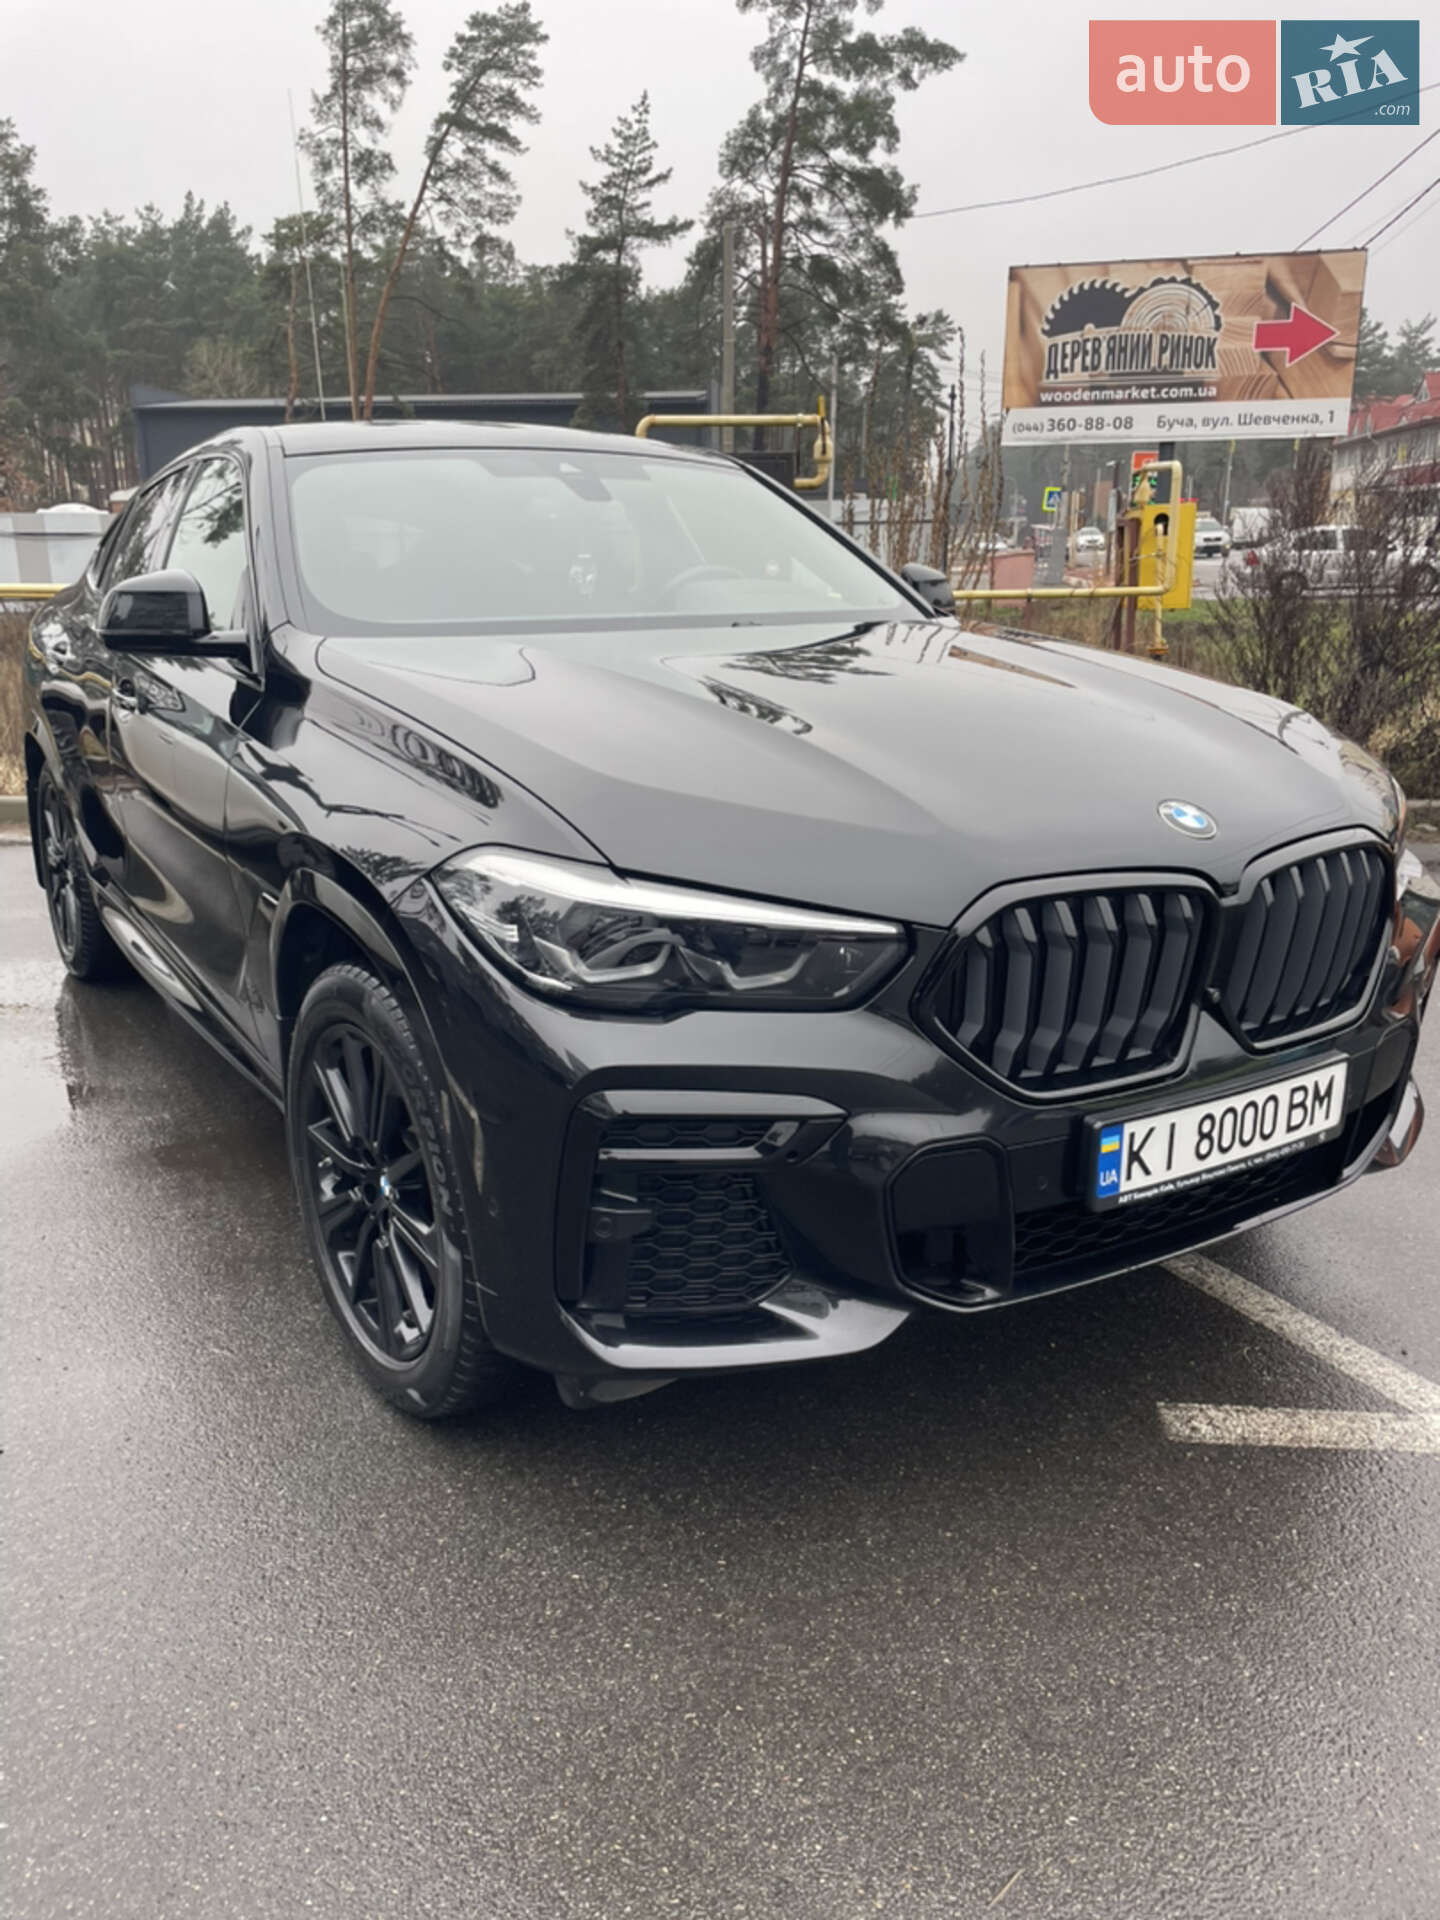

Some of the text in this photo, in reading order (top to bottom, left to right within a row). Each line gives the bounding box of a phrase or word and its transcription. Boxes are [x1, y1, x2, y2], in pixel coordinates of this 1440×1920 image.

[1157, 333, 1218, 369] РИНОК
[1040, 386, 1218, 403] woodenmarket.com.ua
[1012, 416, 1134, 434] (044) 360-88-08
[1156, 410, 1335, 431] Буча, вул. Шевченка, 1
[1194, 1094, 1279, 1161] 8000
[1100, 1169, 1119, 1186] UA
